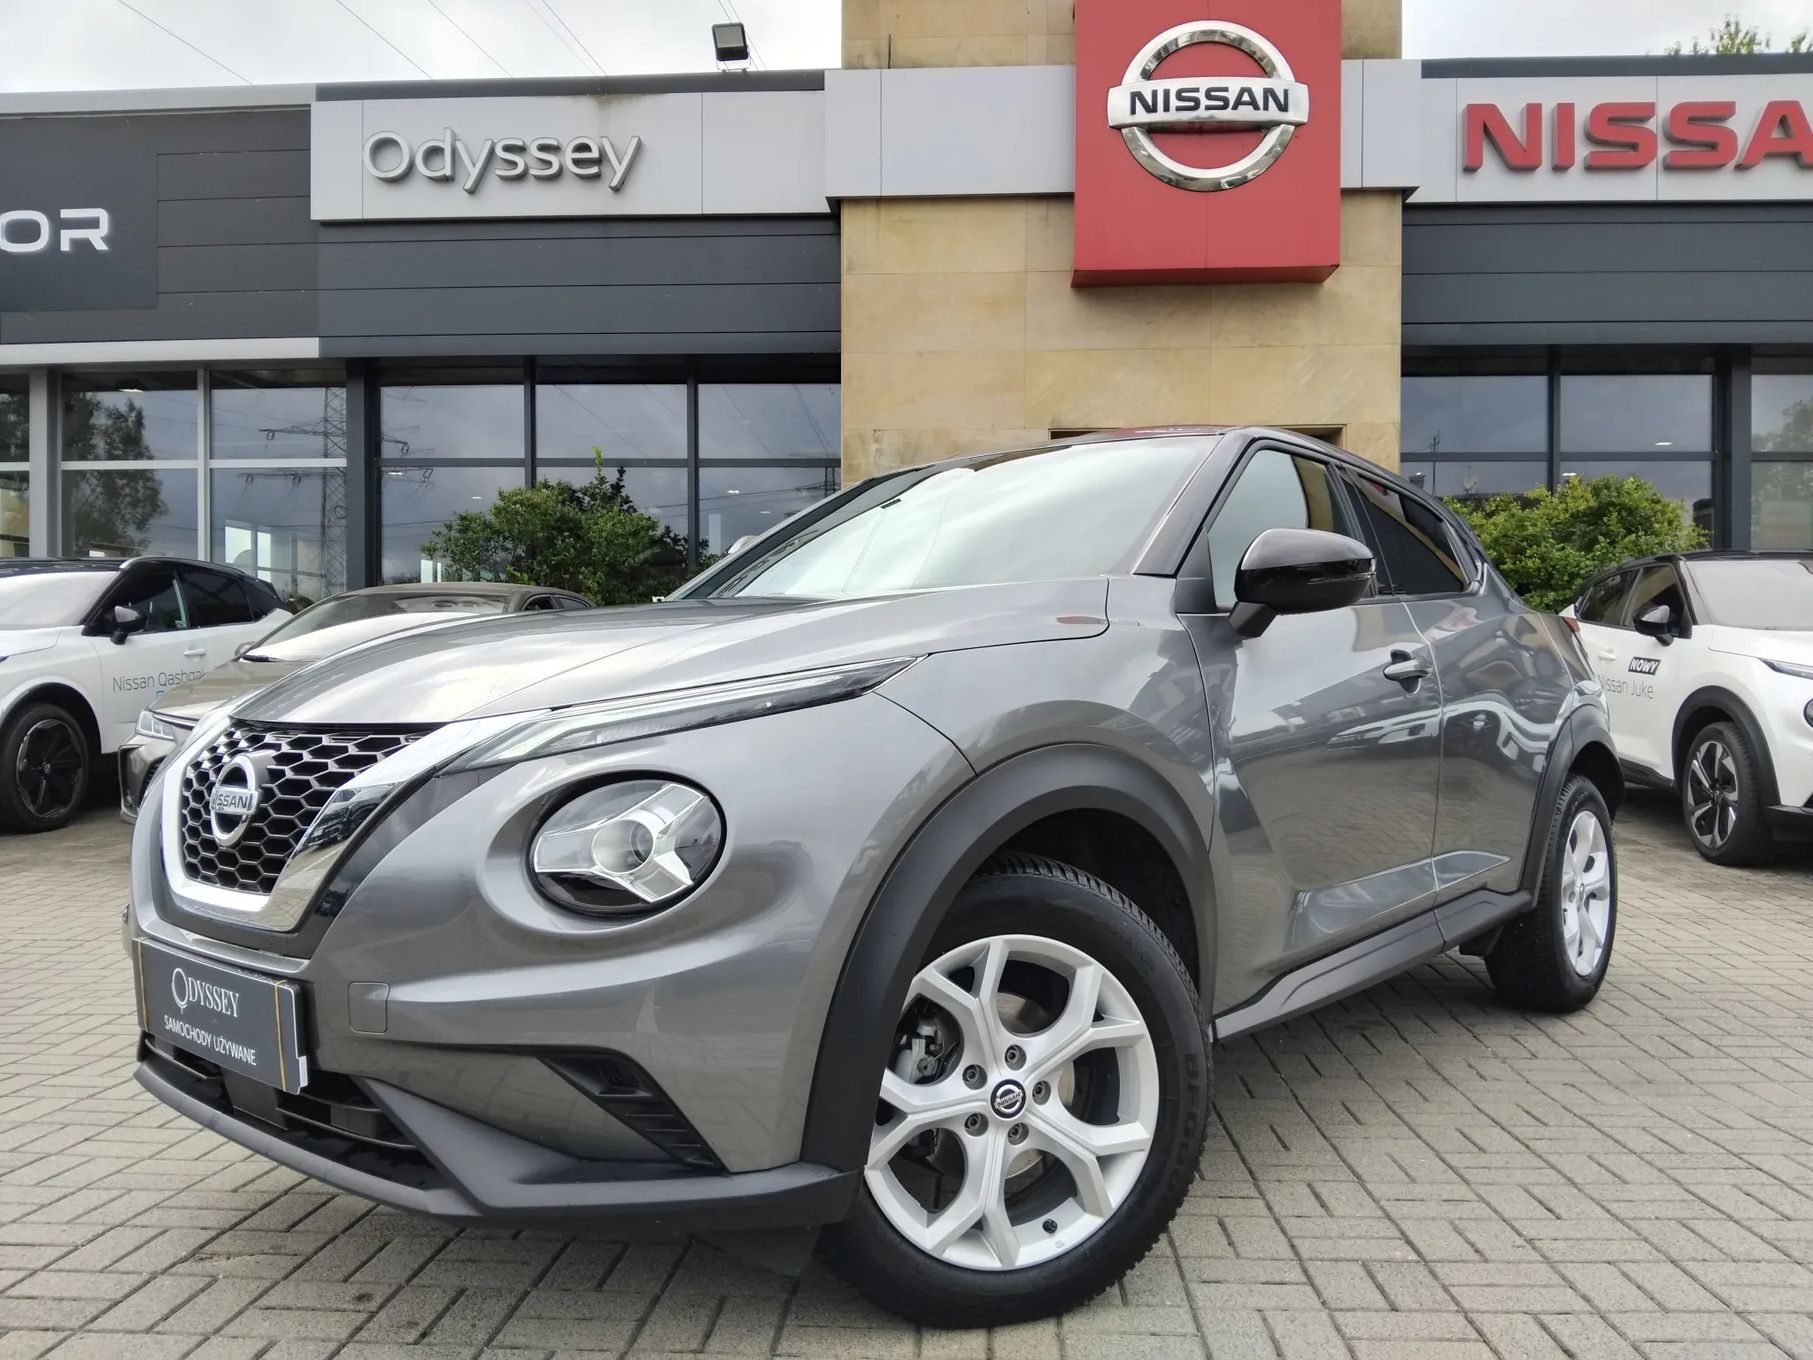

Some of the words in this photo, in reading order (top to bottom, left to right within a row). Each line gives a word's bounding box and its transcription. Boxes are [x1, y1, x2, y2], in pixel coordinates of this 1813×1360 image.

[1129, 86, 1290, 116] NISSAN
[1463, 100, 1813, 171] NISSA
[363, 127, 643, 194] Odyssey
[0, 208, 108, 252] OR
[113, 675, 154, 692] Nissan
[1630, 659, 1658, 673] NOWY
[1631, 680, 1654, 699] Juke
[172, 967, 239, 1017] ODYSSEY
[164, 1015, 212, 1048] SAMOCHODY
[213, 1036, 256, 1065] UŻYWANE
